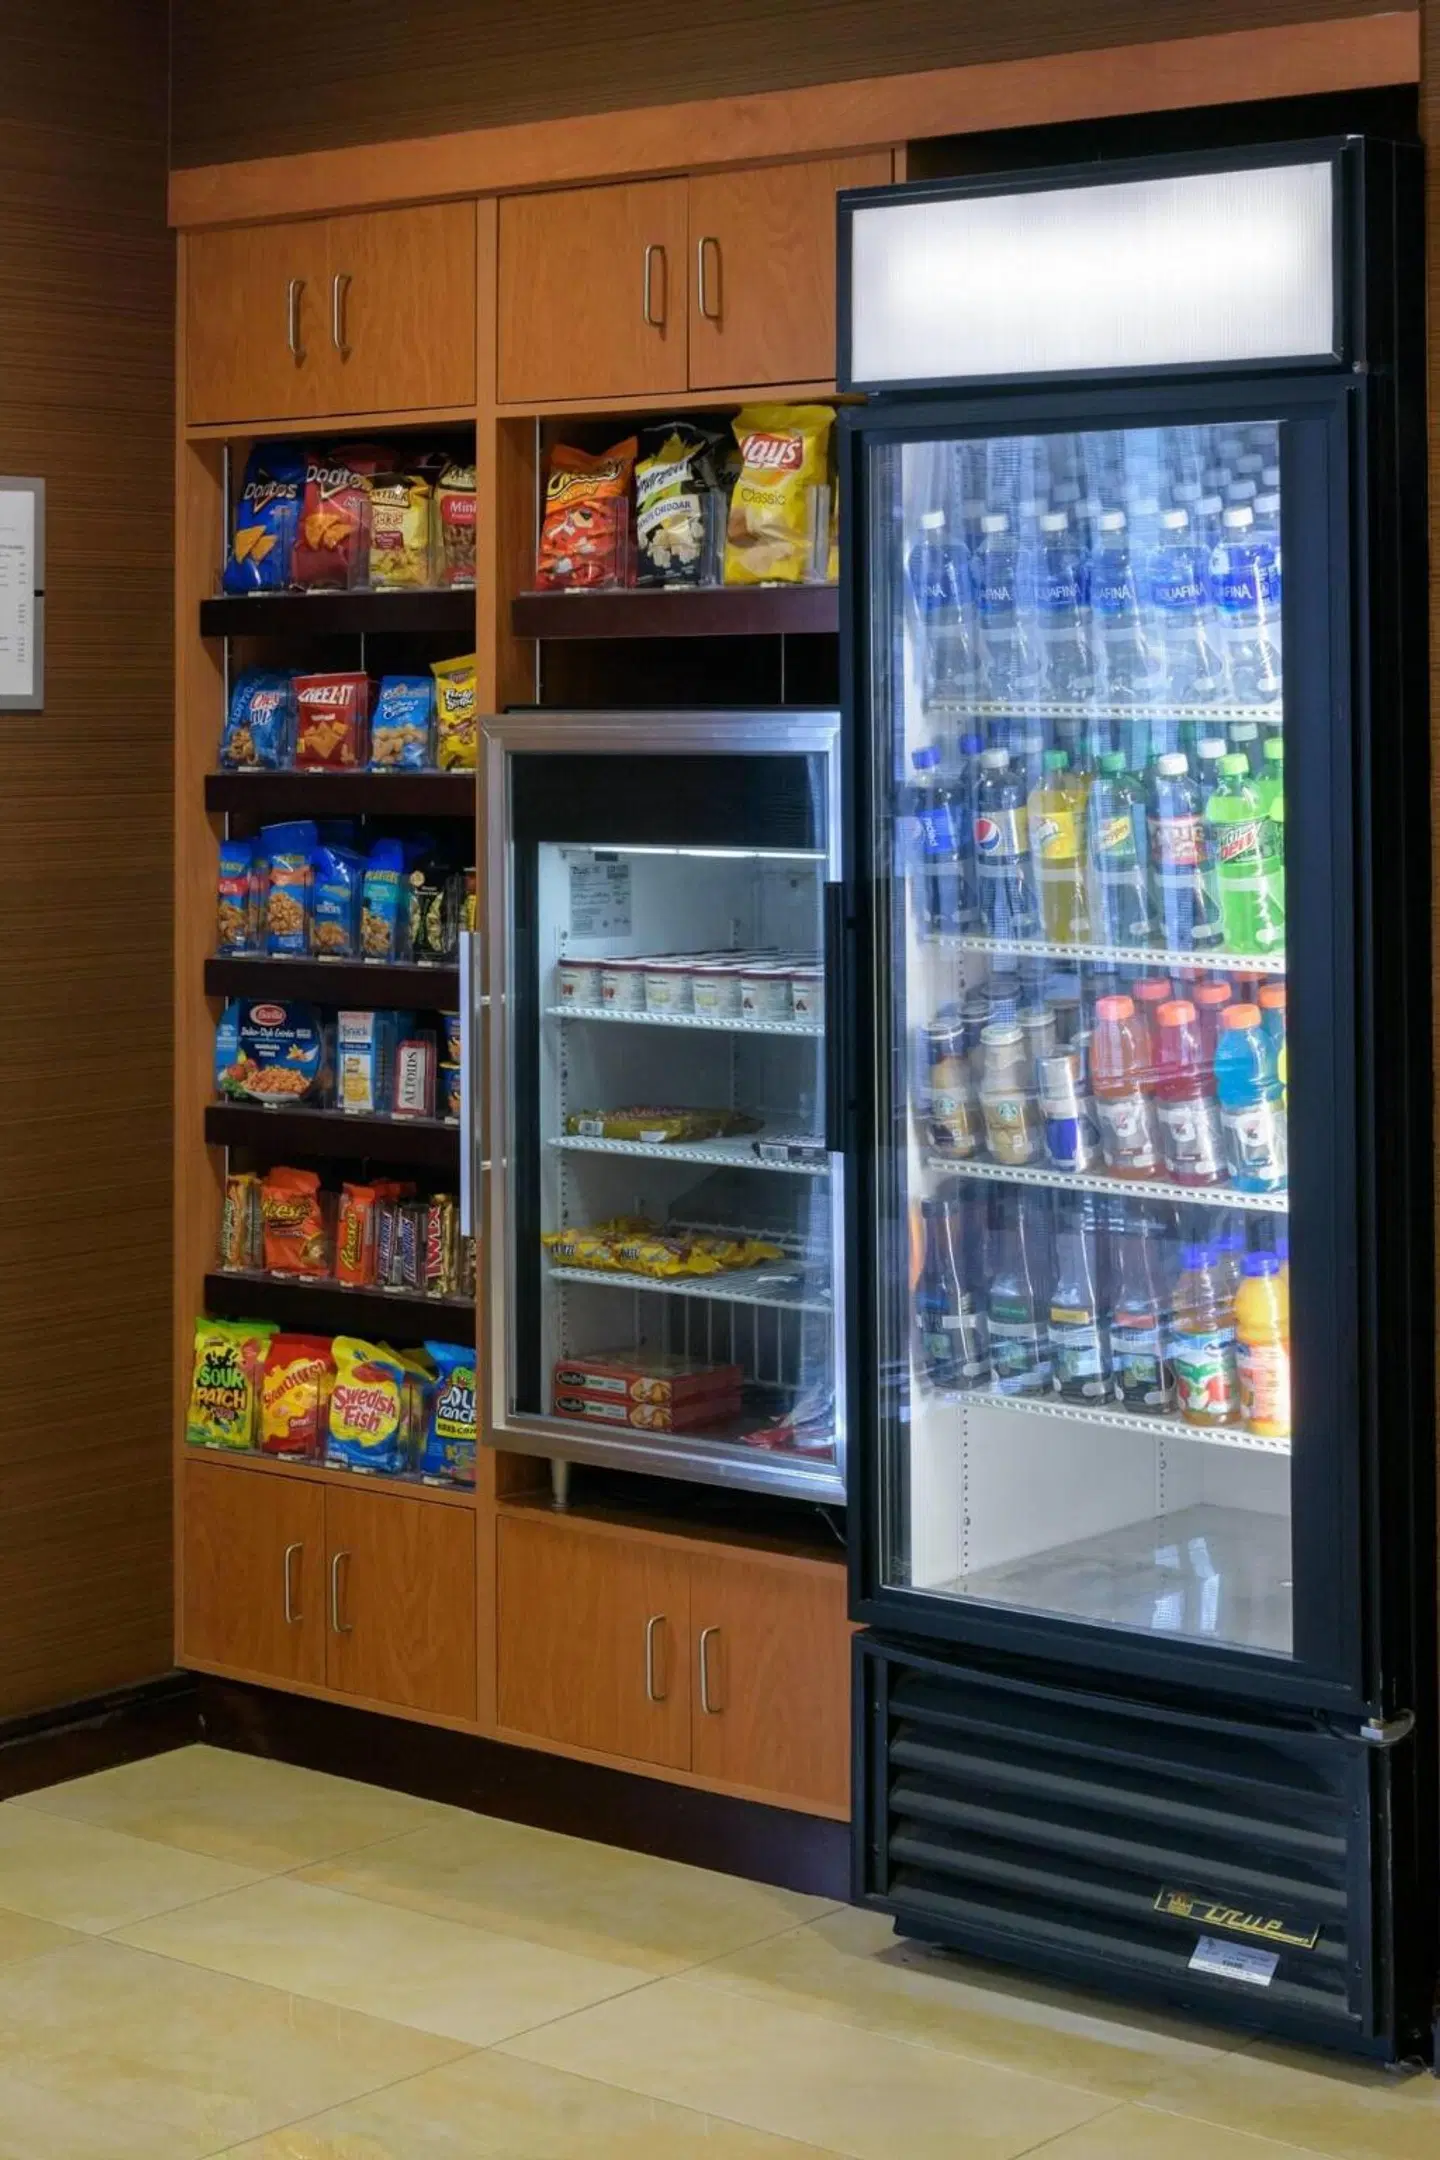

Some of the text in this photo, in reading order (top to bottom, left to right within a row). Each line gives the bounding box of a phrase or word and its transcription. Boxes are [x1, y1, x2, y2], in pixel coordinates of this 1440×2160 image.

[741, 432, 802, 466] Lay's
[243, 481, 298, 501] Doritos
[741, 487, 786, 506] Classic
[654, 500, 692, 520] CHEDDAR
[404, 1050, 417, 1105] ALTOIDS
[199, 1366, 245, 1389] SOUR
[196, 1385, 248, 1409] PATCH
[333, 1385, 397, 1417] Swedish
[342, 1405, 382, 1432] Fish
